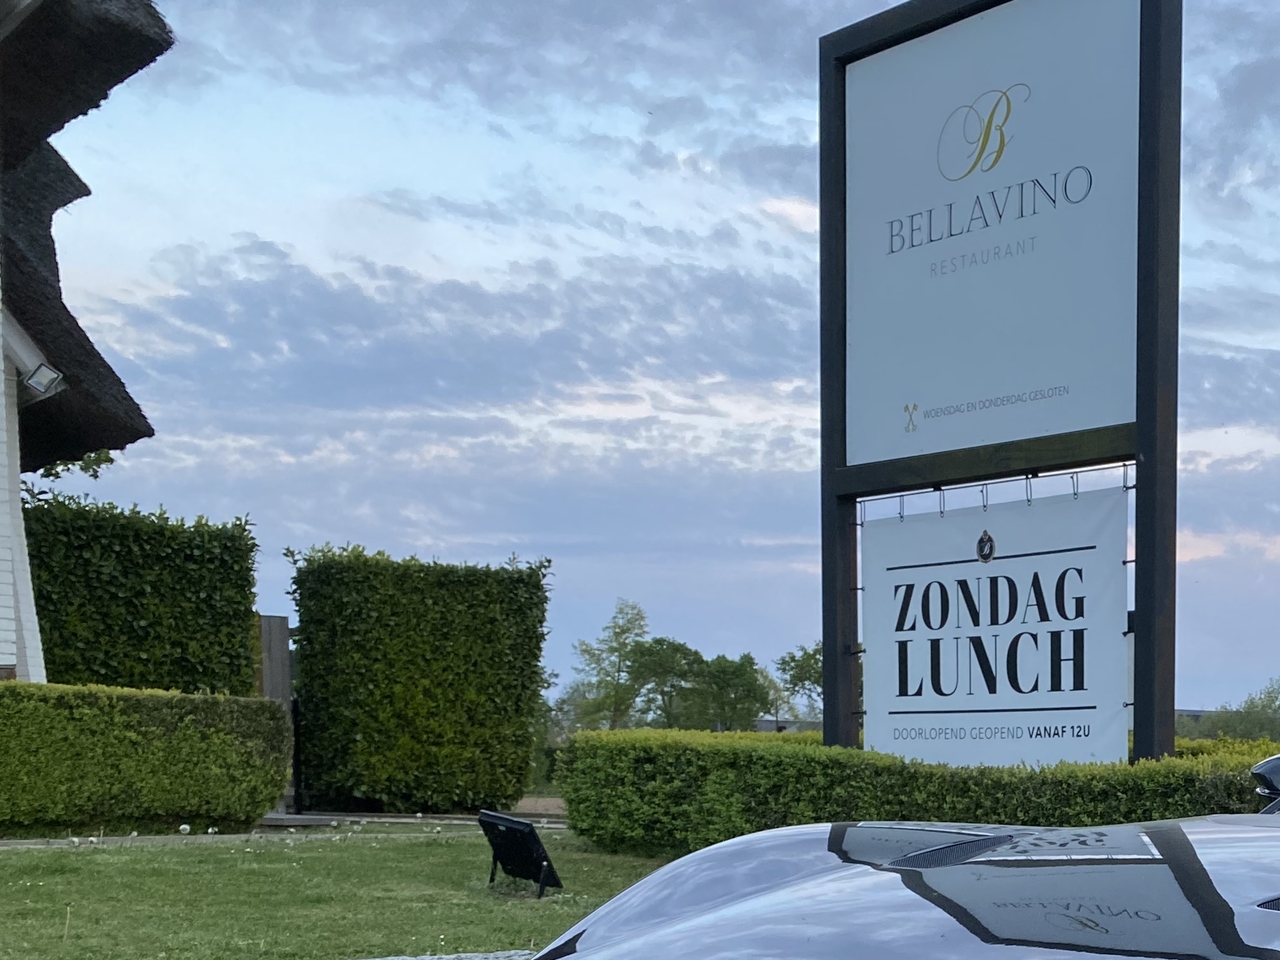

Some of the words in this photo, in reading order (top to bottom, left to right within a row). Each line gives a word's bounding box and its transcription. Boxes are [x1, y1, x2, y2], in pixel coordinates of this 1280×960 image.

[885, 166, 1093, 256] BELLAVINO
[930, 236, 1038, 277] RESTAURANT
[923, 404, 966, 419] WOENSDAG
[966, 402, 977, 412] EN
[979, 392, 1027, 410] DONDERDAG
[1028, 385, 1070, 401] GESLOTEN
[894, 567, 1086, 632] ZONDAG
[895, 628, 1088, 697] LUNCH
[893, 727, 967, 740] DOORLOPEND
[969, 726, 1024, 740] GEOPEND
[1027, 726, 1067, 738] VANAF
[1070, 725, 1091, 738] 12U
